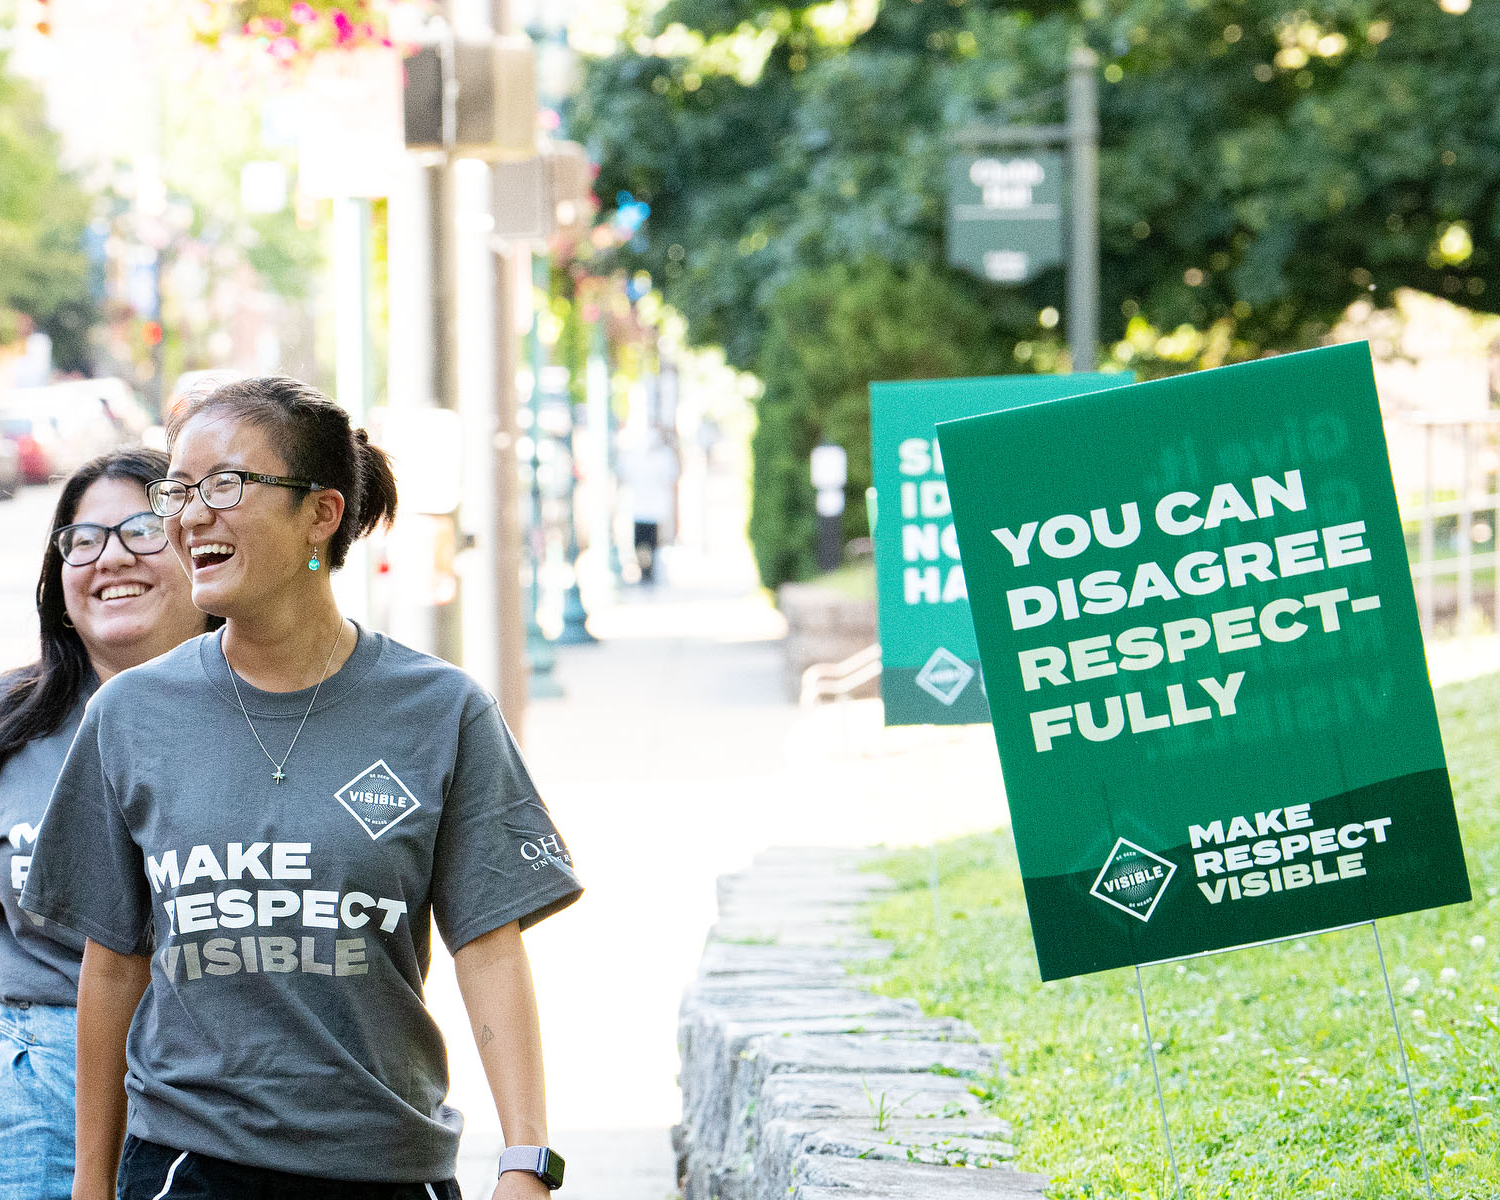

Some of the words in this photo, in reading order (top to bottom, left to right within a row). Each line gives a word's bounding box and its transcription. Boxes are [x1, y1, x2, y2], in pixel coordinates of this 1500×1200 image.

[991, 501, 1142, 568] YOU
[1155, 469, 1307, 536] CAN
[1005, 520, 1372, 631] DISAGREE
[1017, 587, 1382, 692] RESPECT-
[1029, 671, 1246, 753] FULLY
[349, 790, 407, 808] VISIBLE
[520, 833, 568, 860] OH
[1188, 802, 1314, 849] MAKE
[1193, 816, 1393, 878] RESPECT
[147, 842, 312, 894] MAKE
[1103, 865, 1164, 893] VISIBLE
[1196, 852, 1367, 905] VISIBLE
[160, 936, 369, 983] VISIBLE
